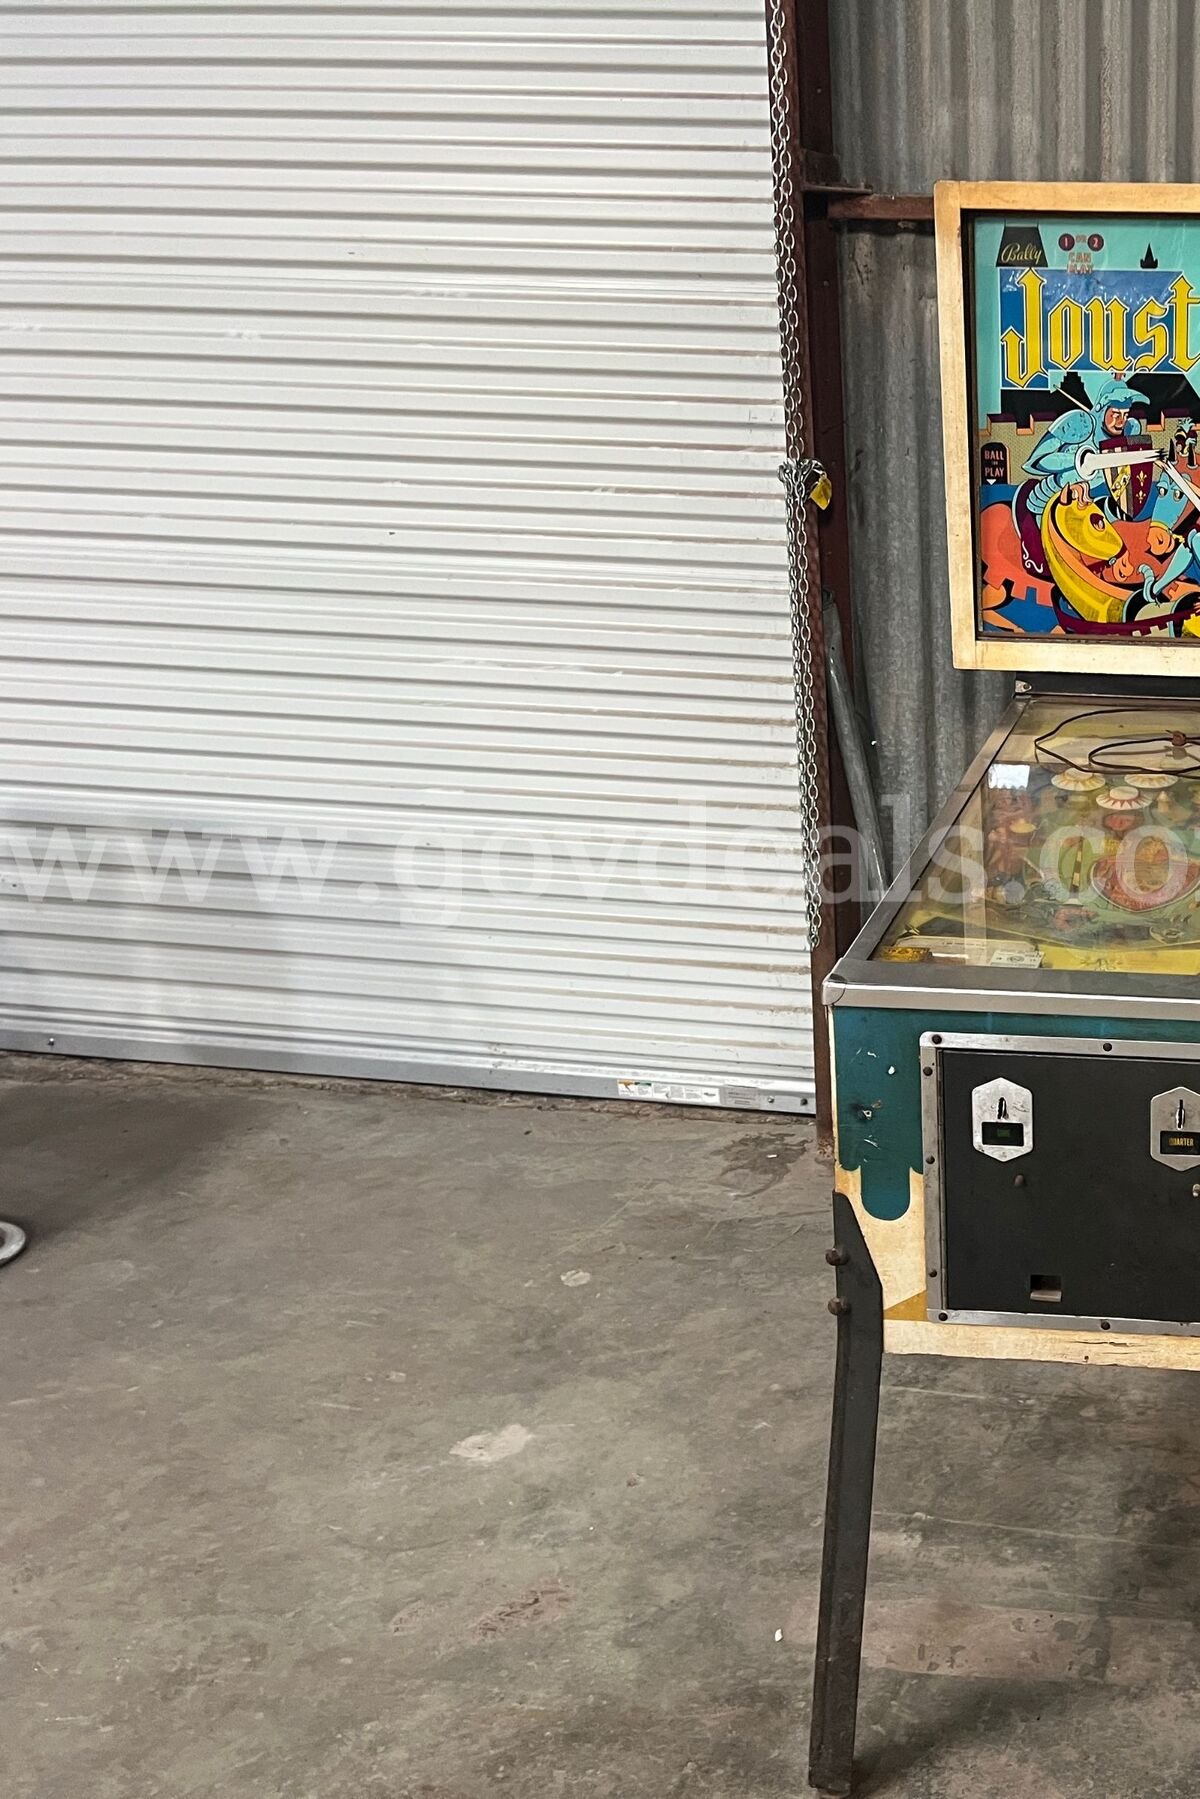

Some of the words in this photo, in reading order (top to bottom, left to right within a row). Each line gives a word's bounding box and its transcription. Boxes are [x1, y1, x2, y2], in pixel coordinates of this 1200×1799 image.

[1001, 242, 1042, 264] Bally
[984, 450, 1005, 460] BALL
[984, 467, 1005, 477] PLAY
